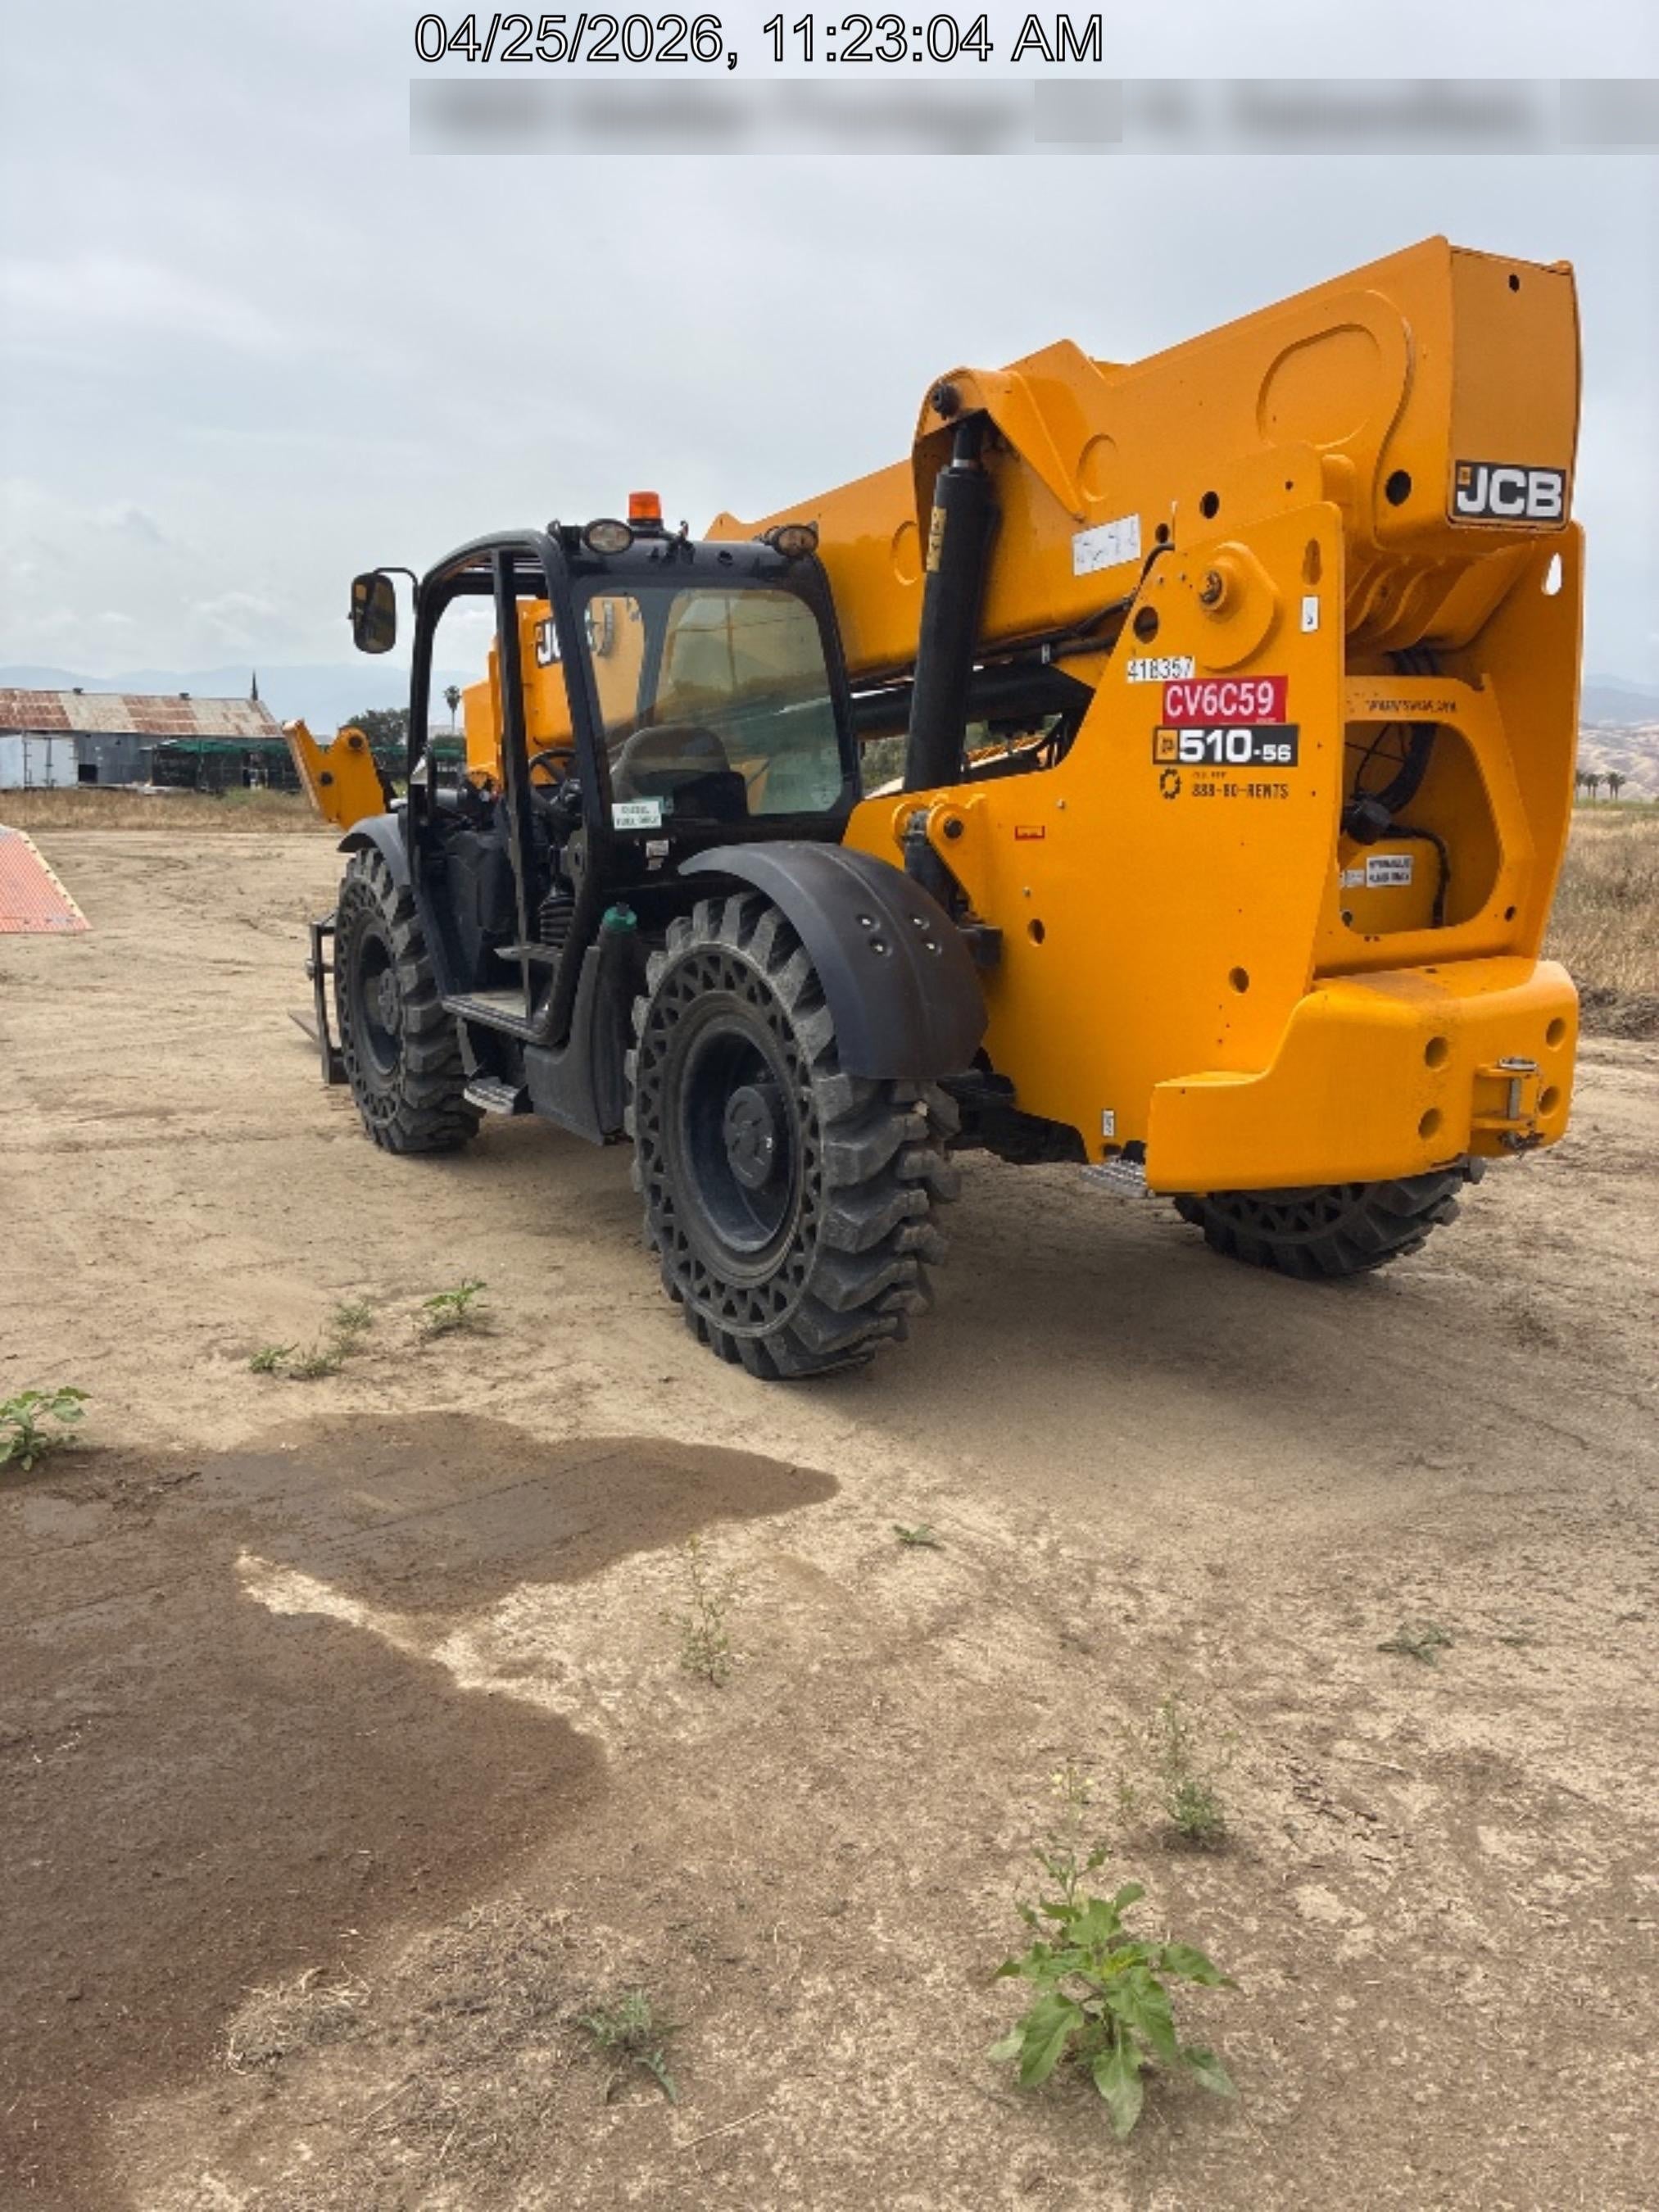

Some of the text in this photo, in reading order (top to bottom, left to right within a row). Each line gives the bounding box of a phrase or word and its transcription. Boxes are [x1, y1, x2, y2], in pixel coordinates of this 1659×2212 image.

[1457, 466, 1562, 518] JCB
[1127, 656, 1193, 679] 418357
[1166, 681, 1275, 717] CV6C59
[1179, 728, 1292, 763] 510-56
